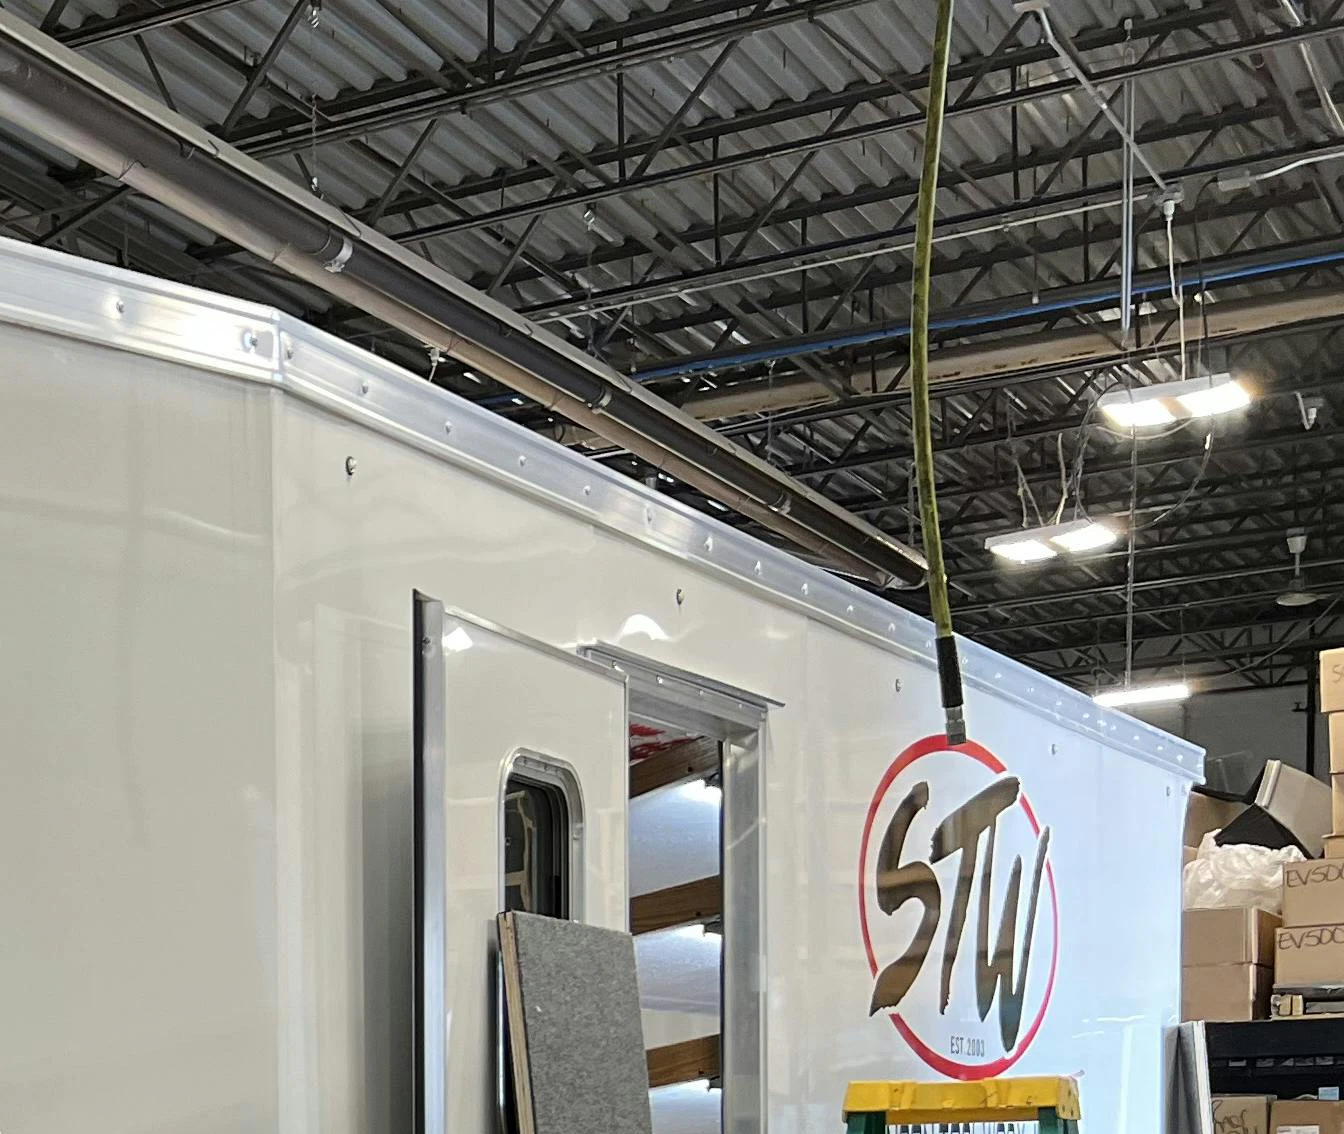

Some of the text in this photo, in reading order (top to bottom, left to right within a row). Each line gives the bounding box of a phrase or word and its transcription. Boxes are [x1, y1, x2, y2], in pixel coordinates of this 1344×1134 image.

[1286, 864, 1344, 888] EVSD
[869, 776, 1051, 1053] STW
[967, 1038, 985, 1057] 2003
